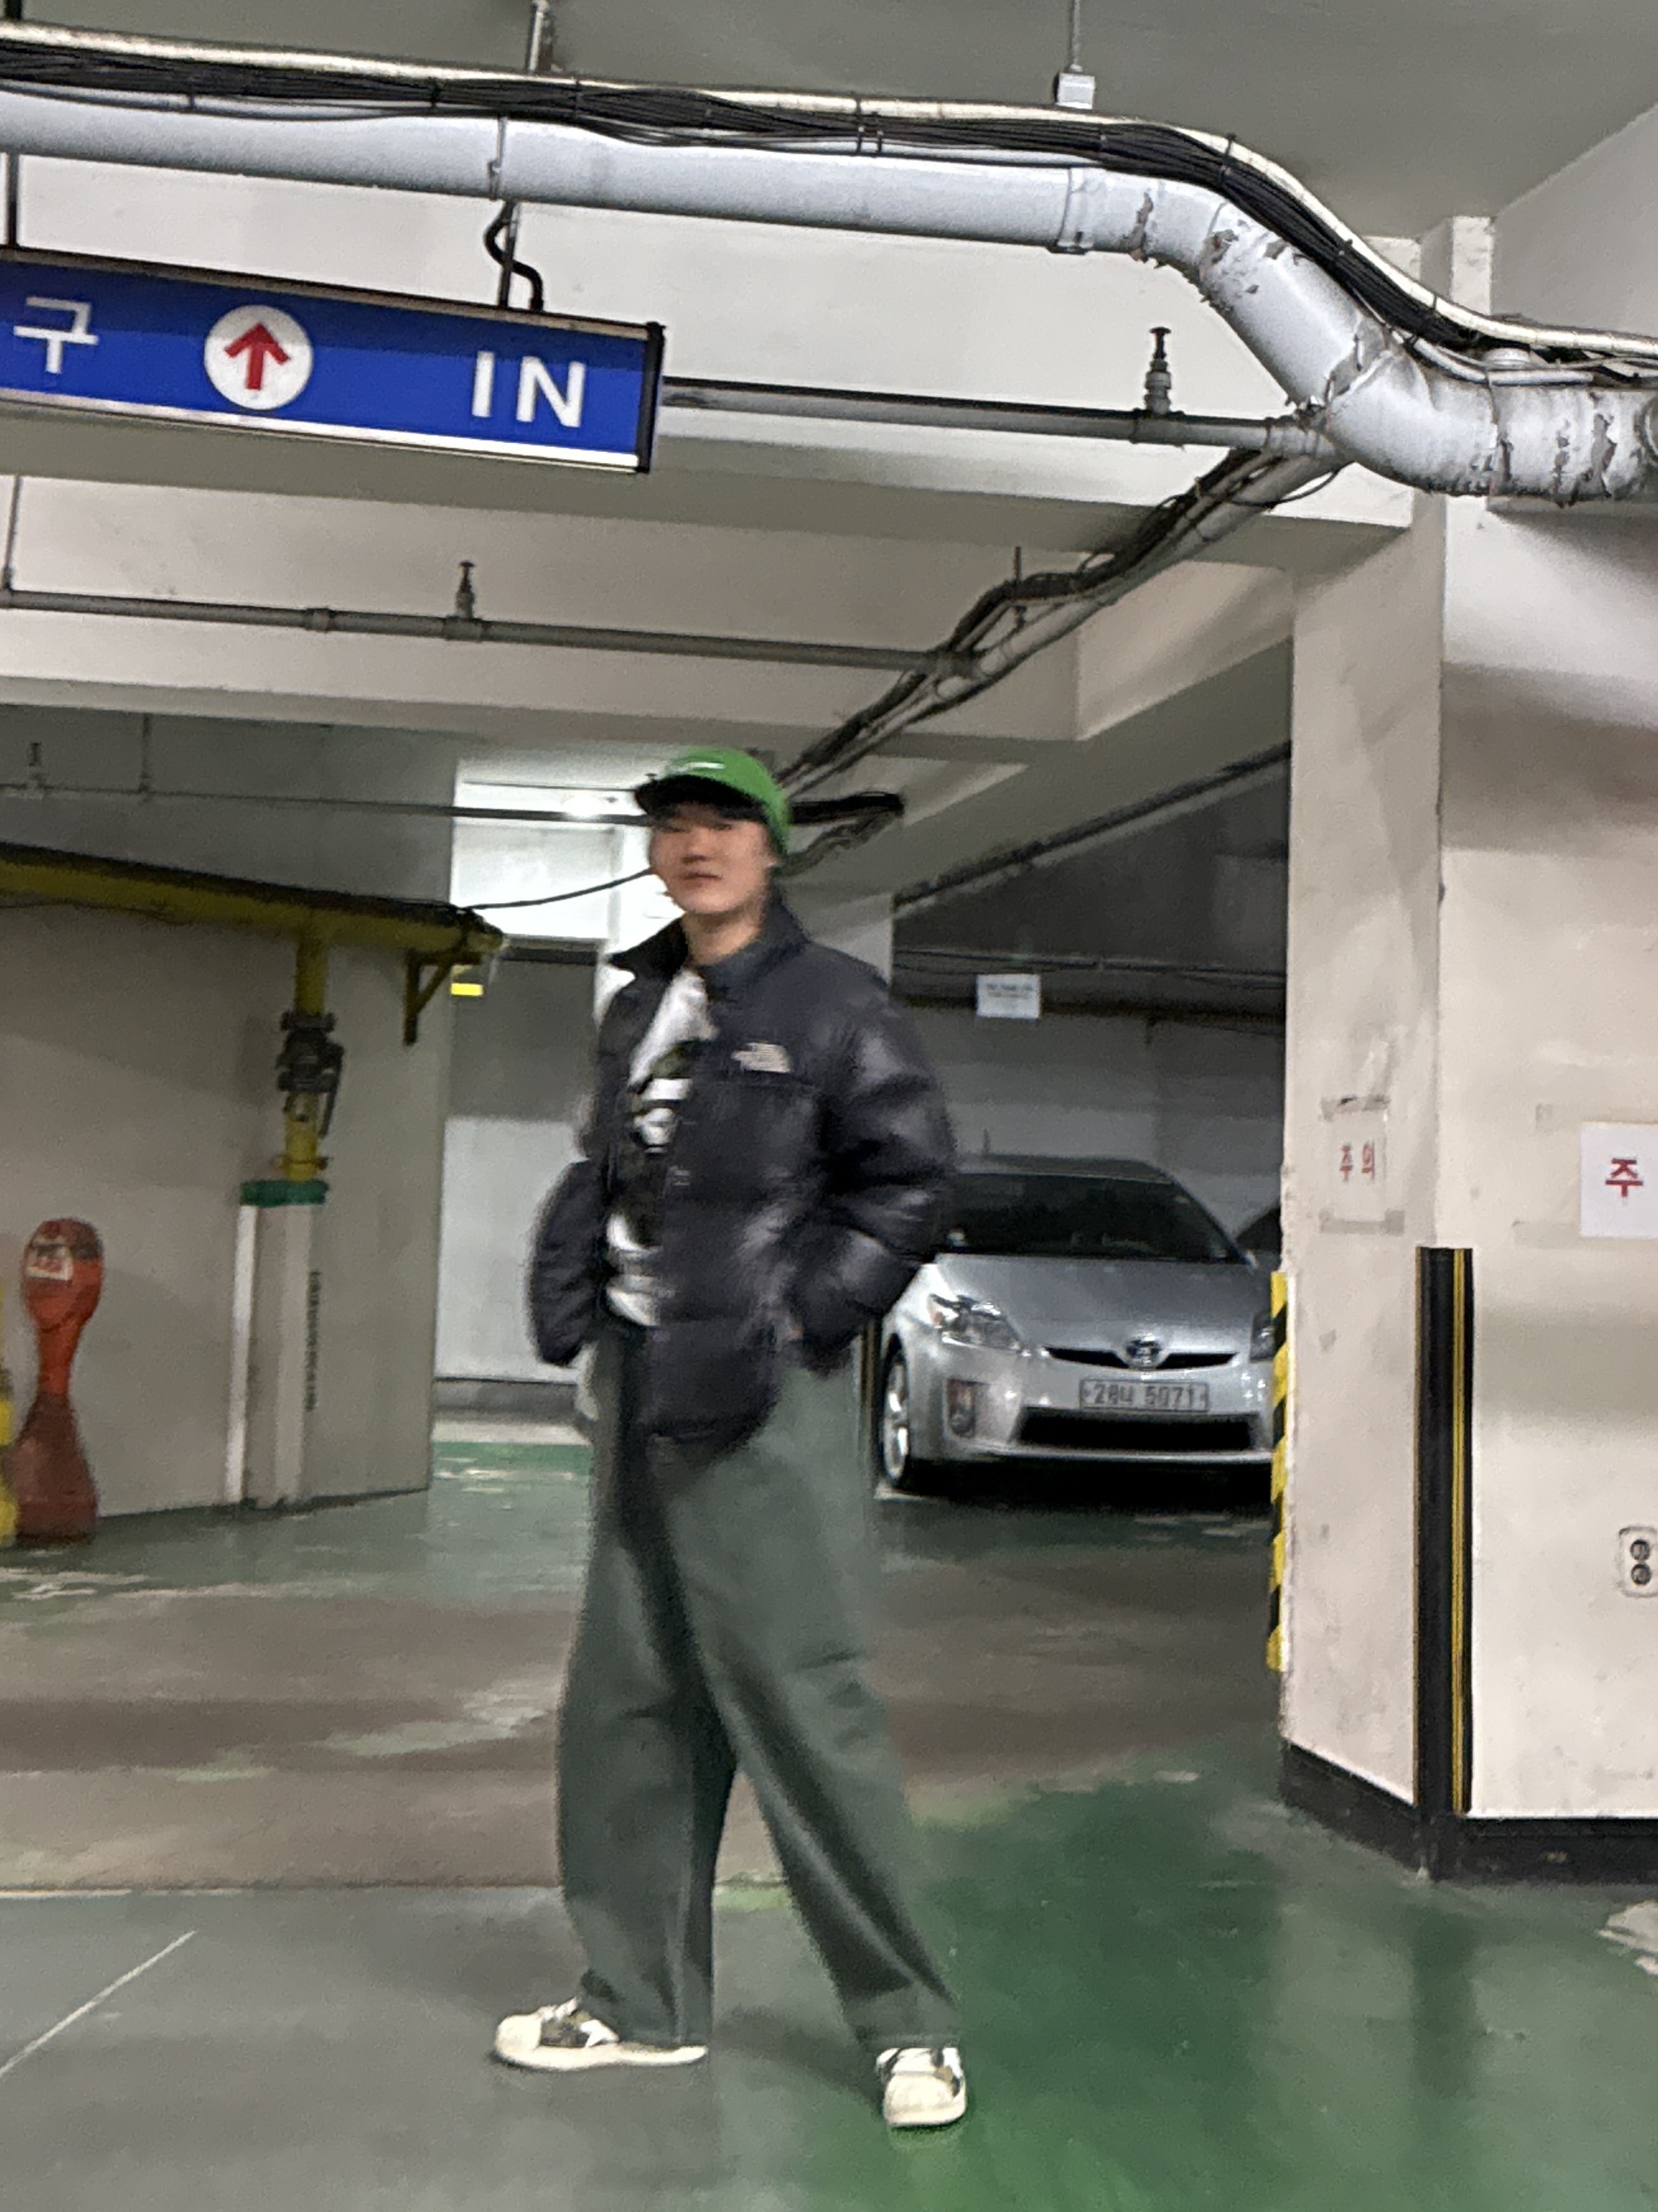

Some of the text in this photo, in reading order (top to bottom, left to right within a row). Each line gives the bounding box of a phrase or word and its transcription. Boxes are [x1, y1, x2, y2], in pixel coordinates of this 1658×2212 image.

[13, 296, 99, 374] 구
[472, 350, 586, 429] IN
[1605, 1158, 1643, 1198] 주
